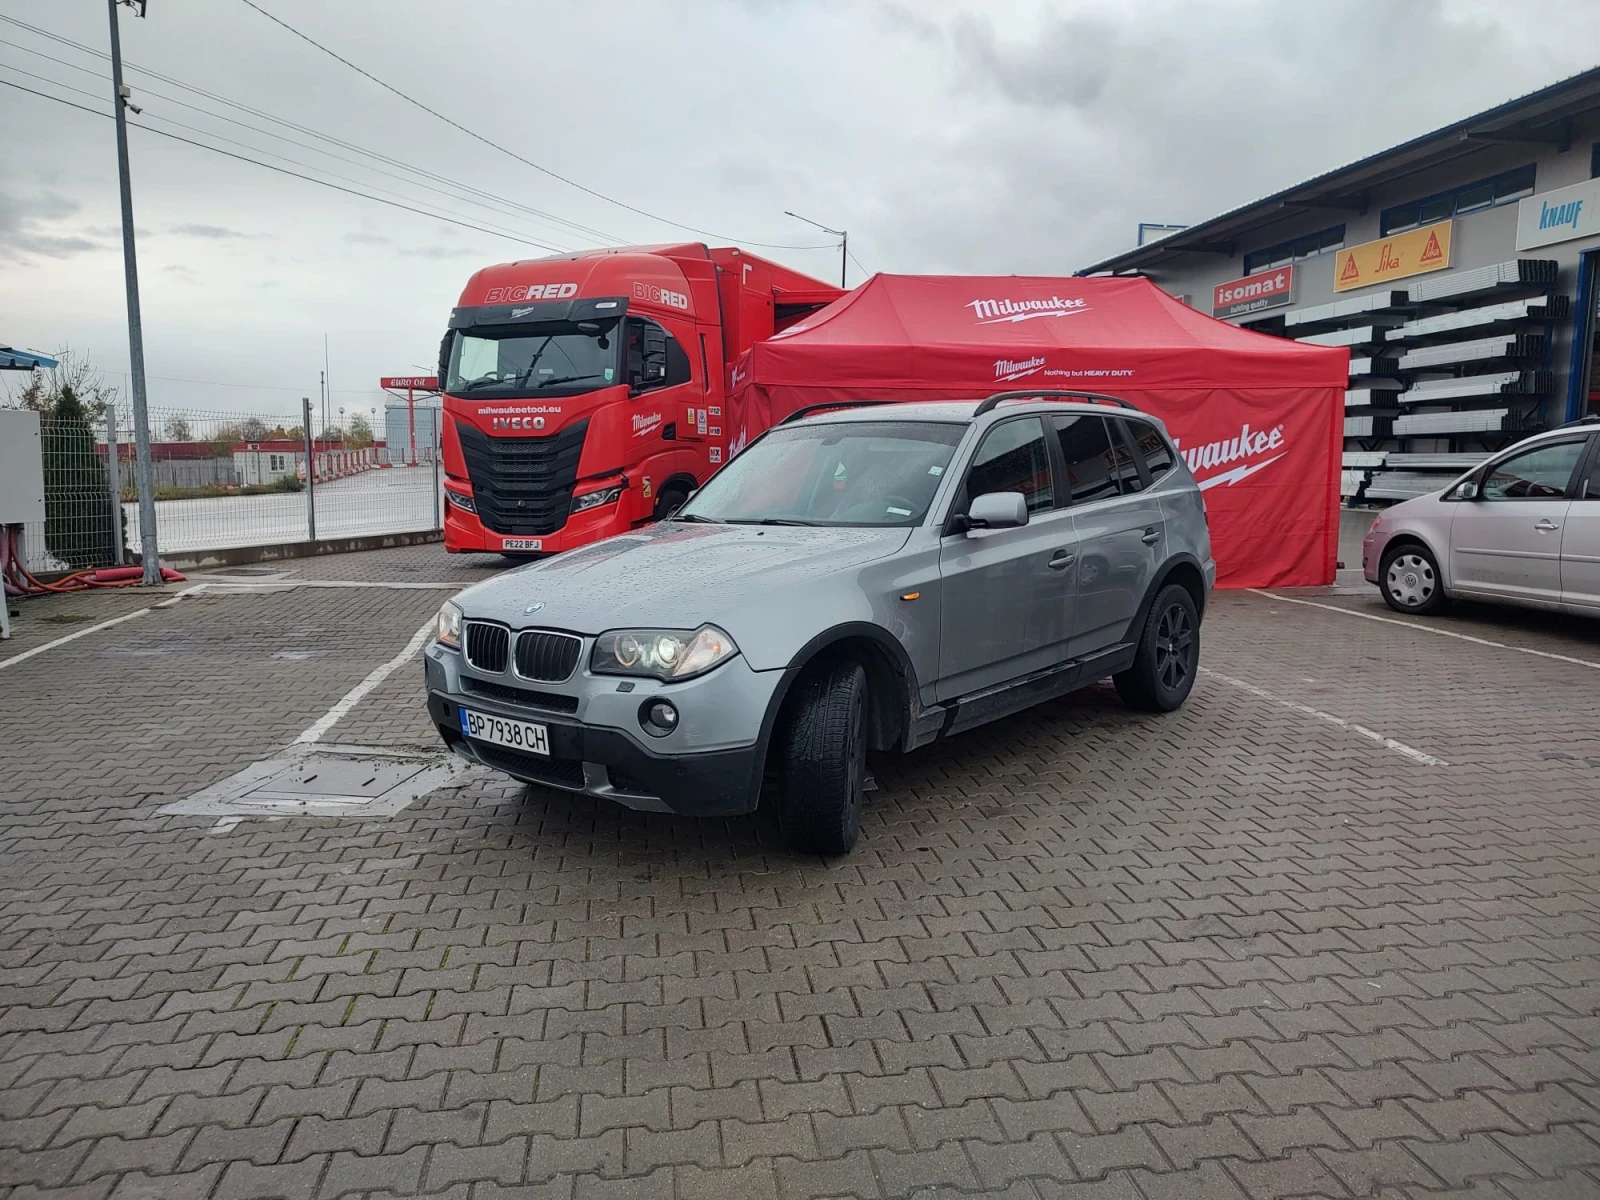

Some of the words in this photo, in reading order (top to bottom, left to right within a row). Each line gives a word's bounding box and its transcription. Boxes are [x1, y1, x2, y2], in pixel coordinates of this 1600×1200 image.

[1539, 200, 1583, 230] KNAUF
[1375, 243, 1400, 273] Sika
[1218, 273, 1285, 304] isomat
[964, 296, 1088, 319] Milwaukee
[1230, 302, 1249, 313] building
[1251, 299, 1268, 309] quality
[993, 356, 1046, 377] Milwaukee
[1043, 369, 1070, 377] Nothing
[477, 405, 562, 415] milwaukeetool.eu
[493, 416, 545, 430] IVECO
[505, 540, 523, 548] PE22
[524, 540, 539, 548] BFJ
[468, 713, 485, 736] BP
[486, 718, 523, 746] 7938
[525, 726, 547, 751] CH
